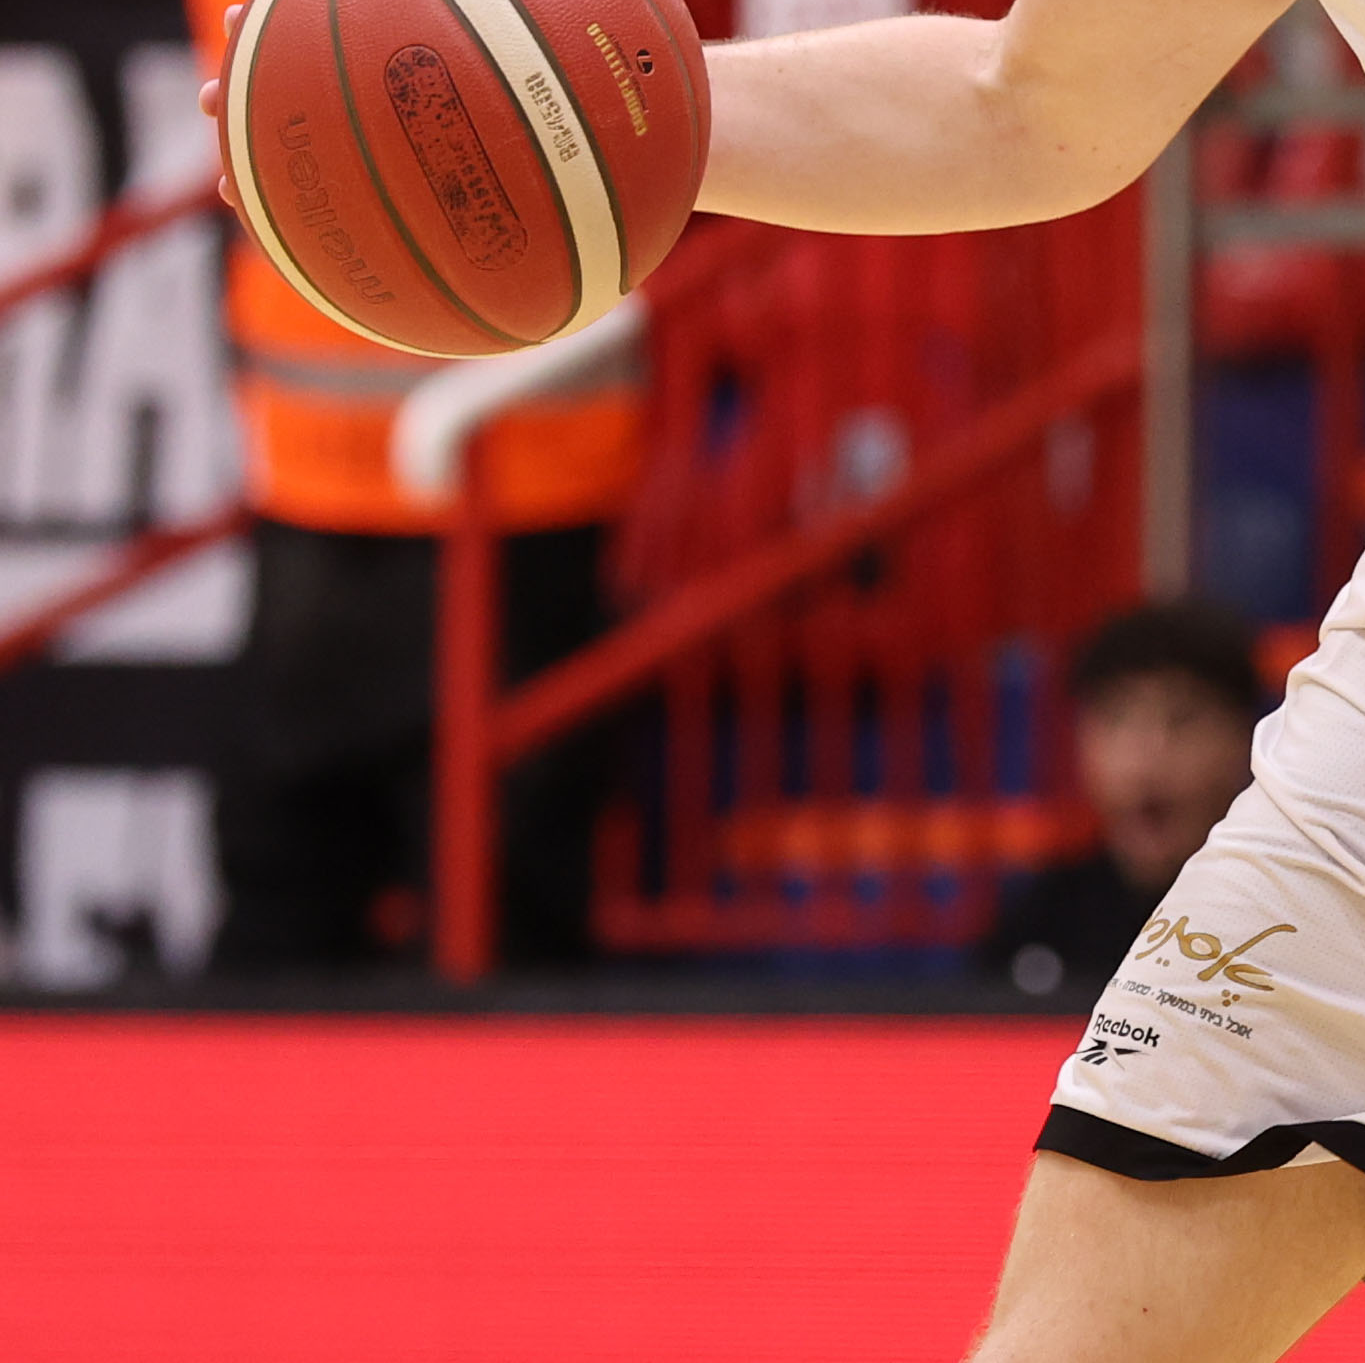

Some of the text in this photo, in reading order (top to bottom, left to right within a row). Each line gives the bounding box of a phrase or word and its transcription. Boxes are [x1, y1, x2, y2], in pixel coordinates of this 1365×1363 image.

[586, 22, 648, 137] COMPETITION
[278, 112, 397, 305] molten
[1092, 1013, 1161, 1048] Reebok
